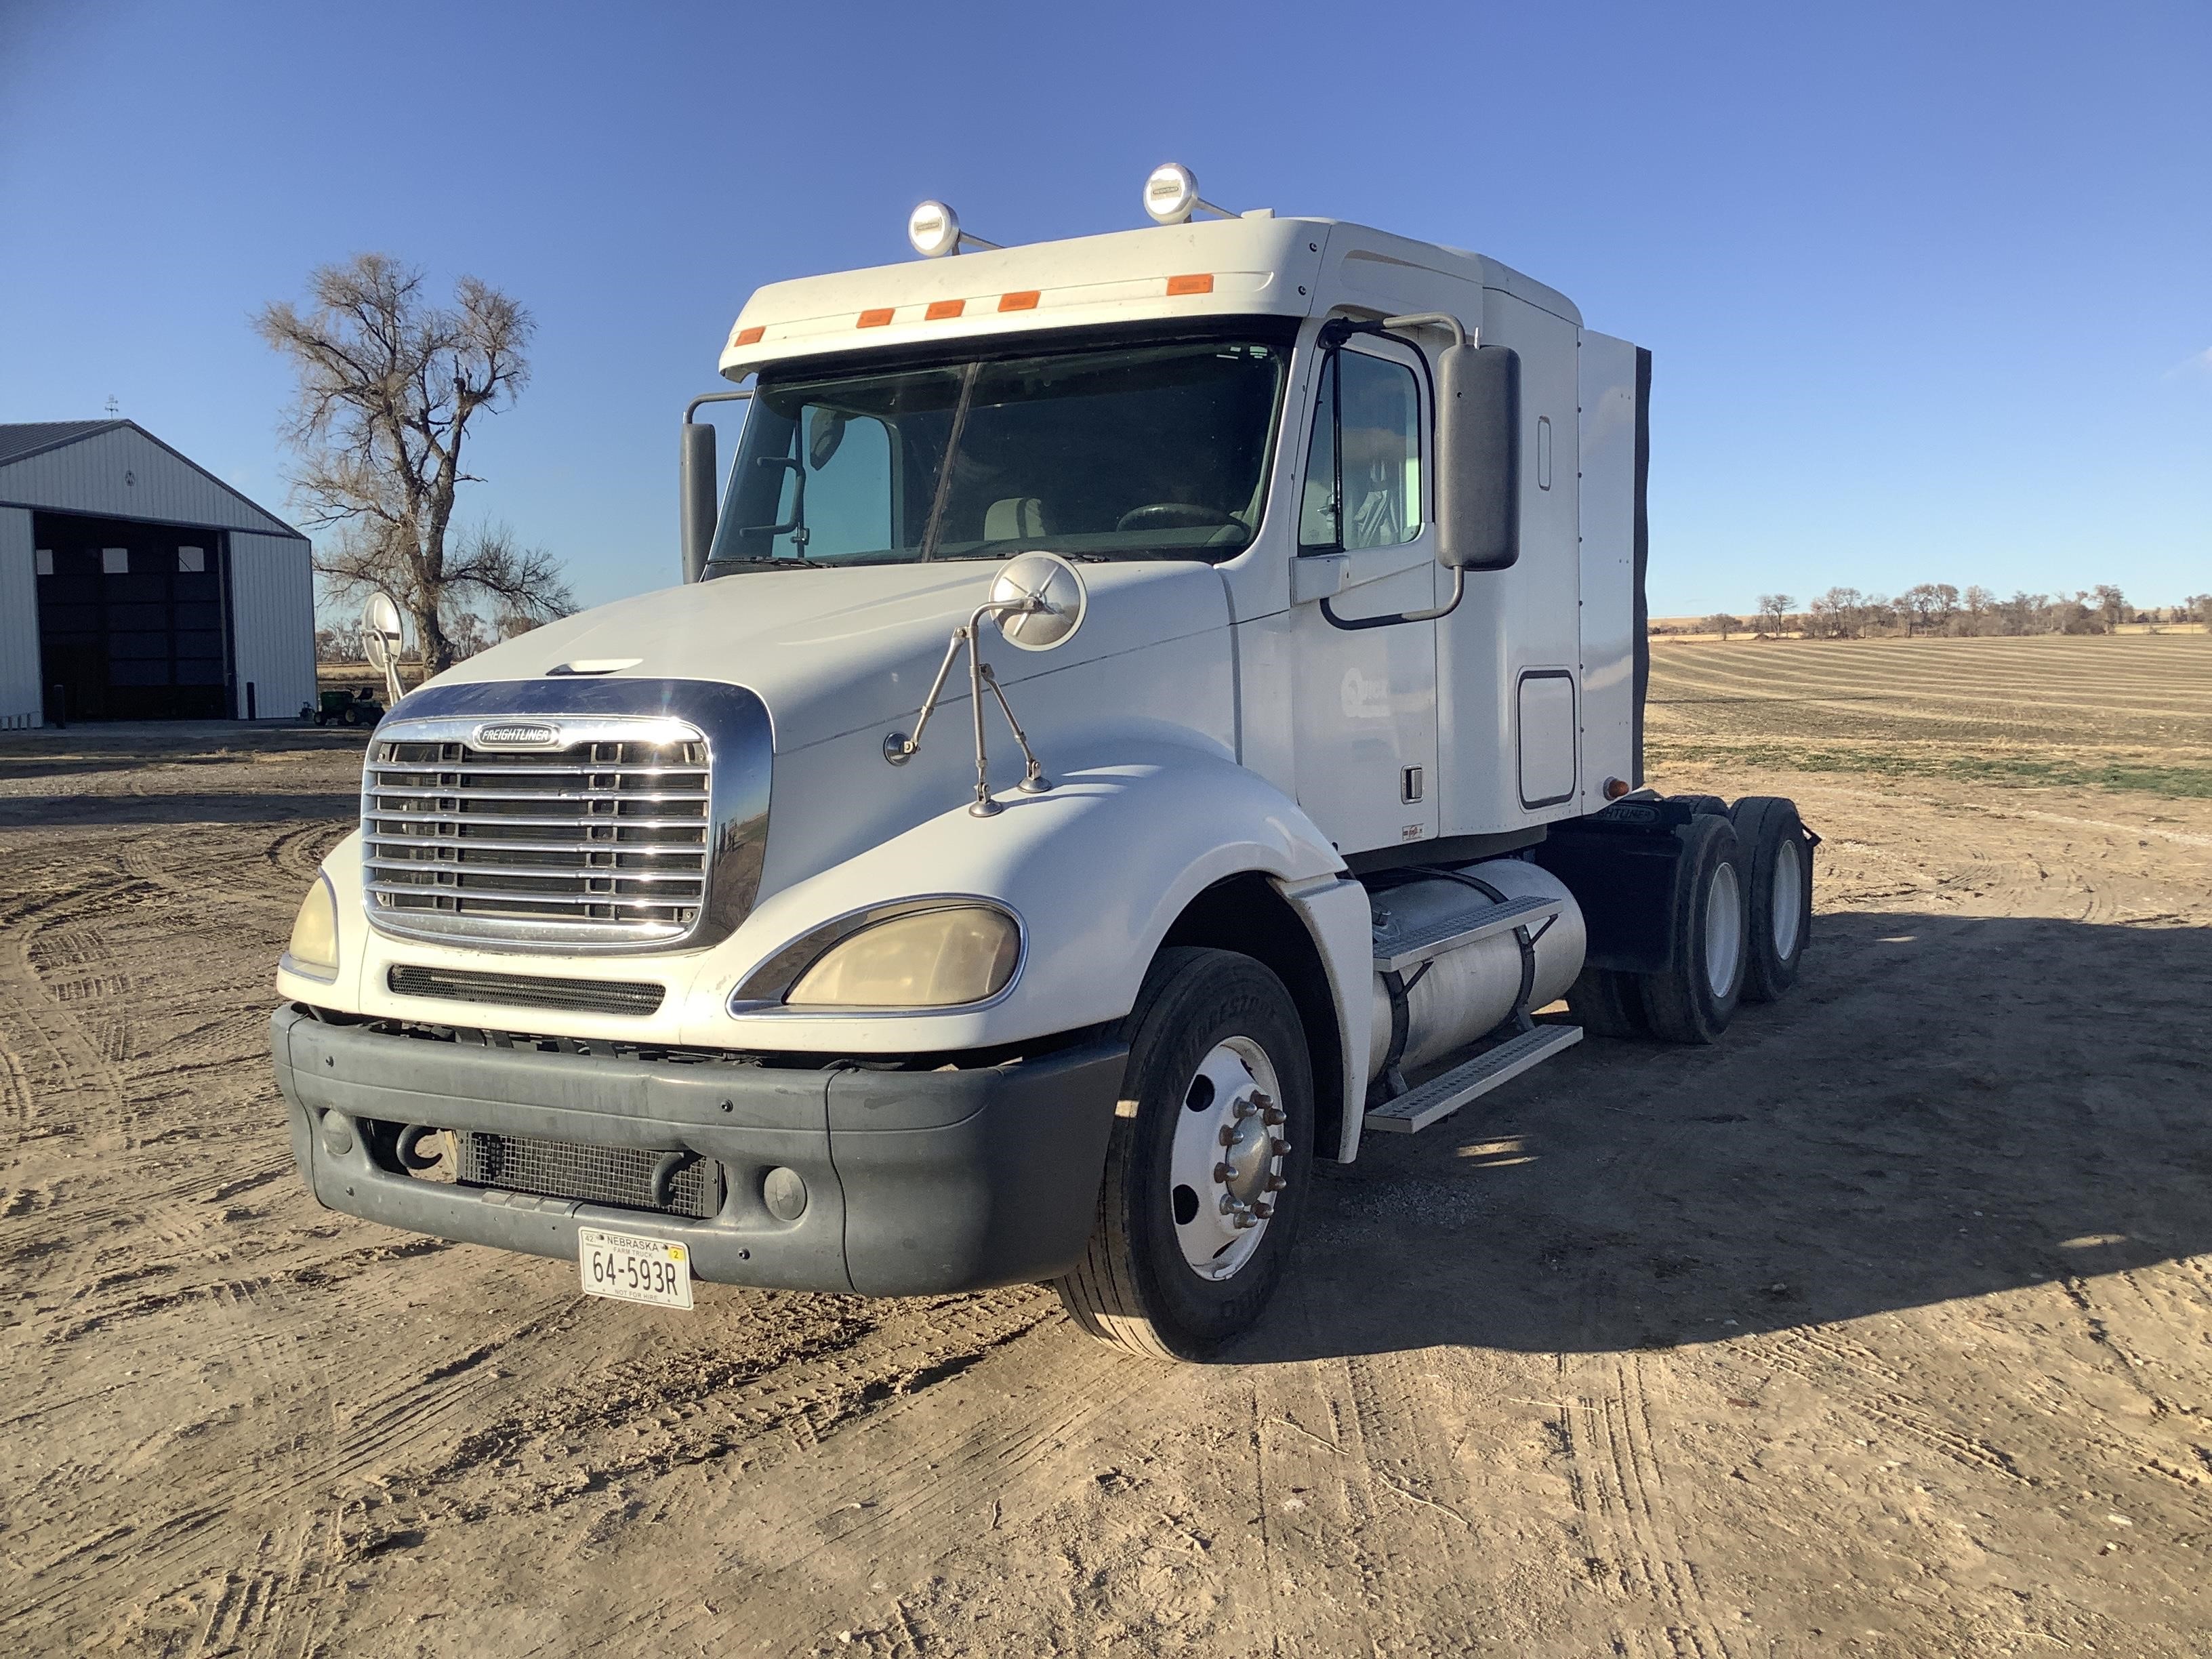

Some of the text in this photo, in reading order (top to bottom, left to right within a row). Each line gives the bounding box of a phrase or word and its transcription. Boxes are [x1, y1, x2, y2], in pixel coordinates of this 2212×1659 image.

[482, 729, 548, 741] FREIGHTLINER
[607, 1236, 659, 1252] NEBRASKA
[593, 1251, 678, 1296] 64-593R
